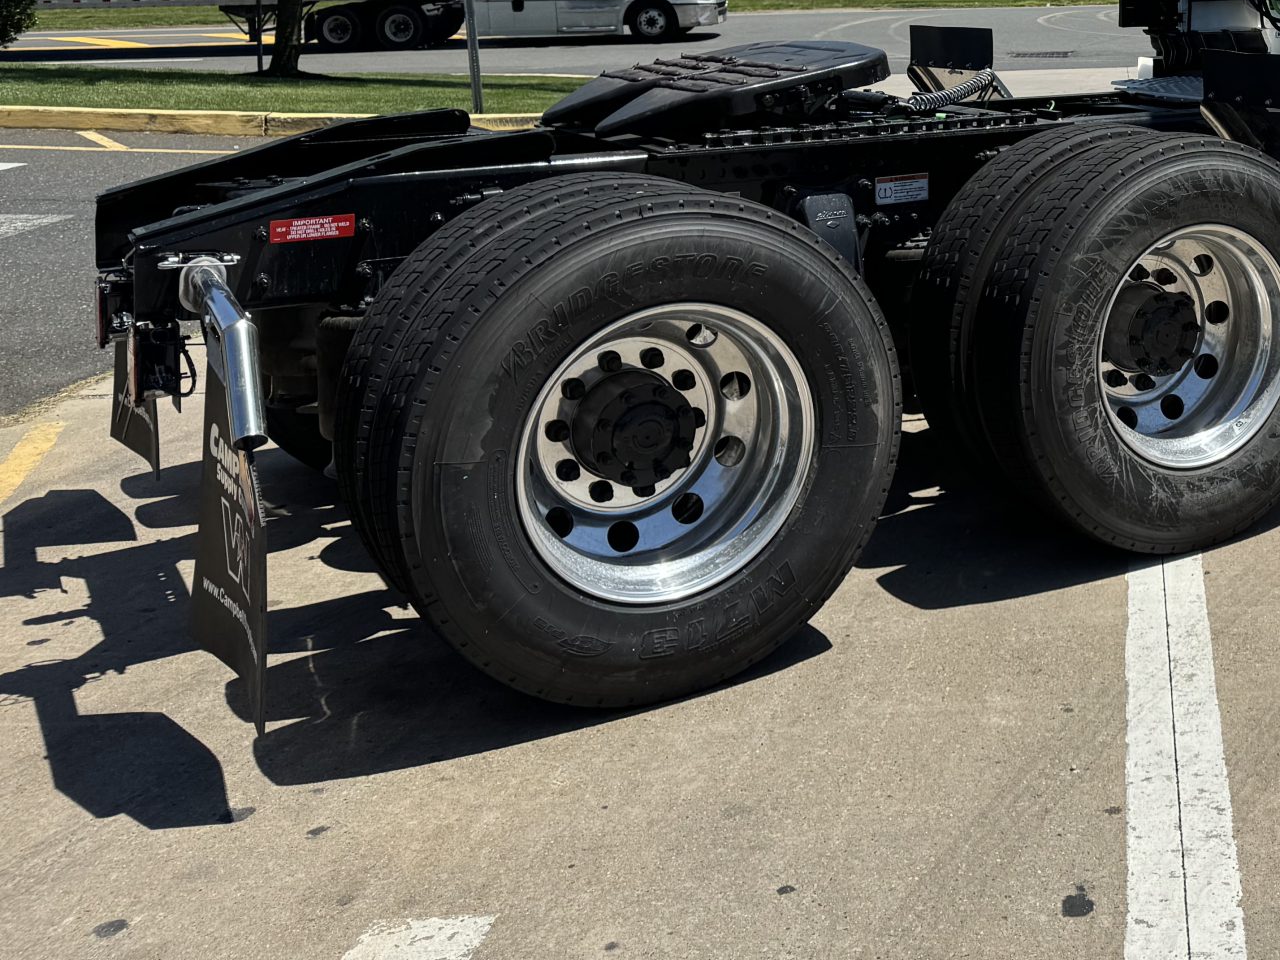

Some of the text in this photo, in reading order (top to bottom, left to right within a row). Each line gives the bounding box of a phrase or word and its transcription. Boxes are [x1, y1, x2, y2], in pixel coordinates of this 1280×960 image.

[292, 217, 333, 227] IMPORTANT
[502, 252, 769, 376] BRIDGESTONE
[209, 422, 240, 479] CAMP
